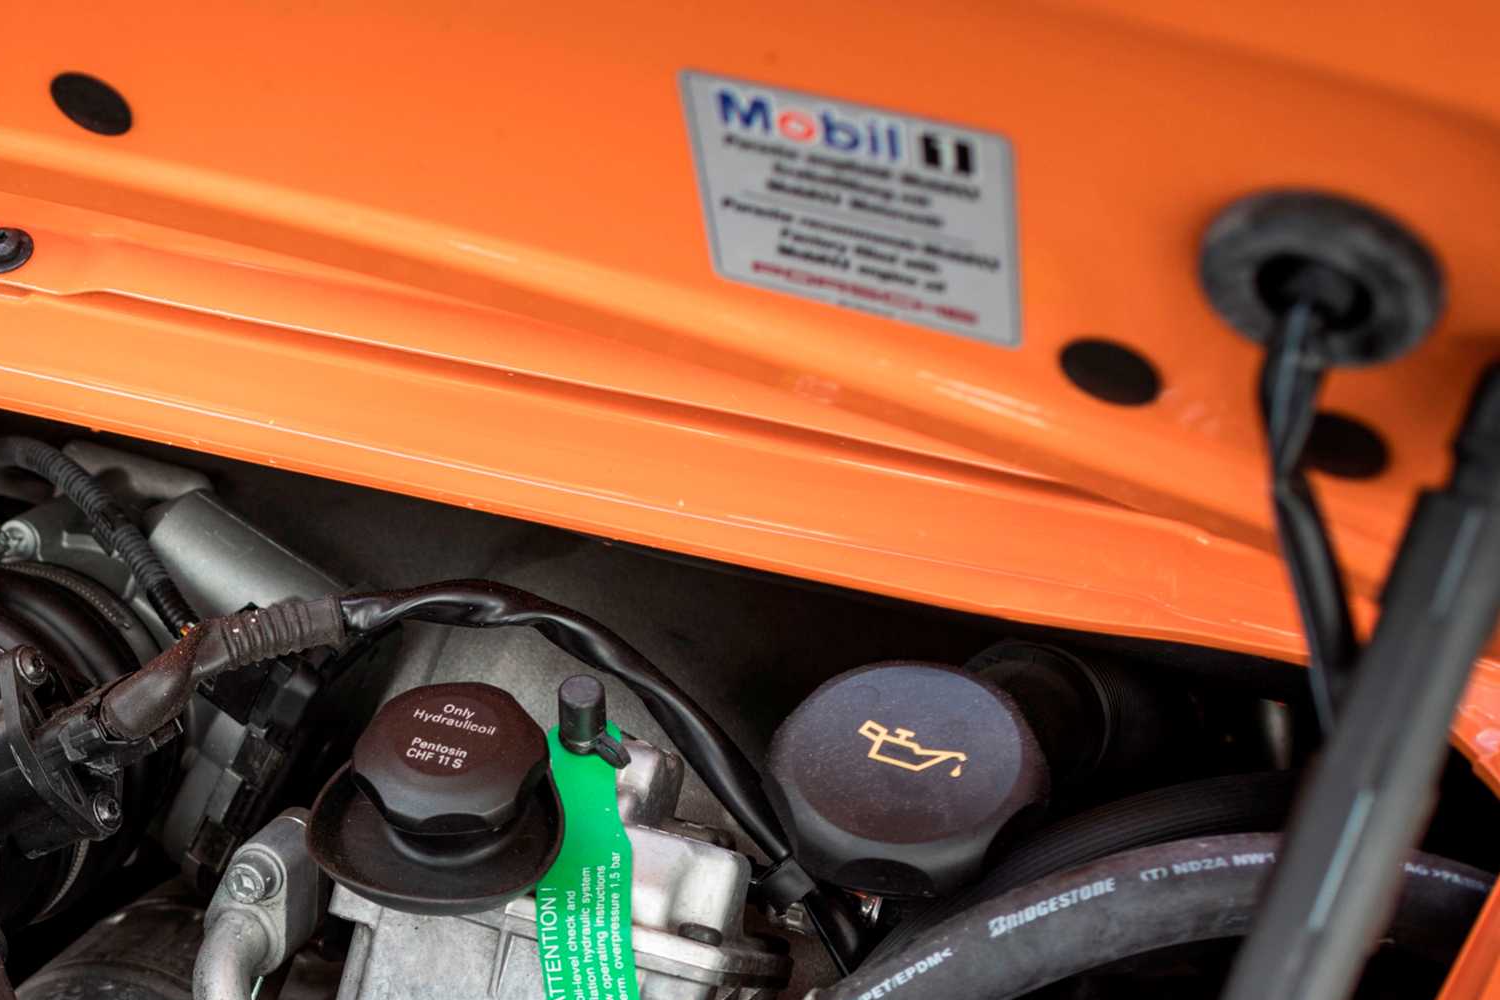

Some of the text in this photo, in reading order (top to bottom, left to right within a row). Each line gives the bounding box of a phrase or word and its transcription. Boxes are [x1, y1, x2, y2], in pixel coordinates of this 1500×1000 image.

[716, 88, 900, 162] Mobil
[412, 708, 497, 736] Hydraulicoil
[443, 703, 476, 720] Only
[406, 747, 464, 769] CHF 11 S
[411, 737, 468, 759] Pentosin
[611, 851, 621, 869] bar
[581, 867, 593, 904] system
[594, 865, 606, 927] instructions
[609, 872, 621, 888] 1.5
[565, 890, 577, 911] and
[987, 876, 1118, 939] BRIDGESTONE
[565, 913, 578, 952] check
[580, 906, 596, 964] hydraulic
[610, 892, 624, 970] overpressure
[596, 930, 613, 990] operating
